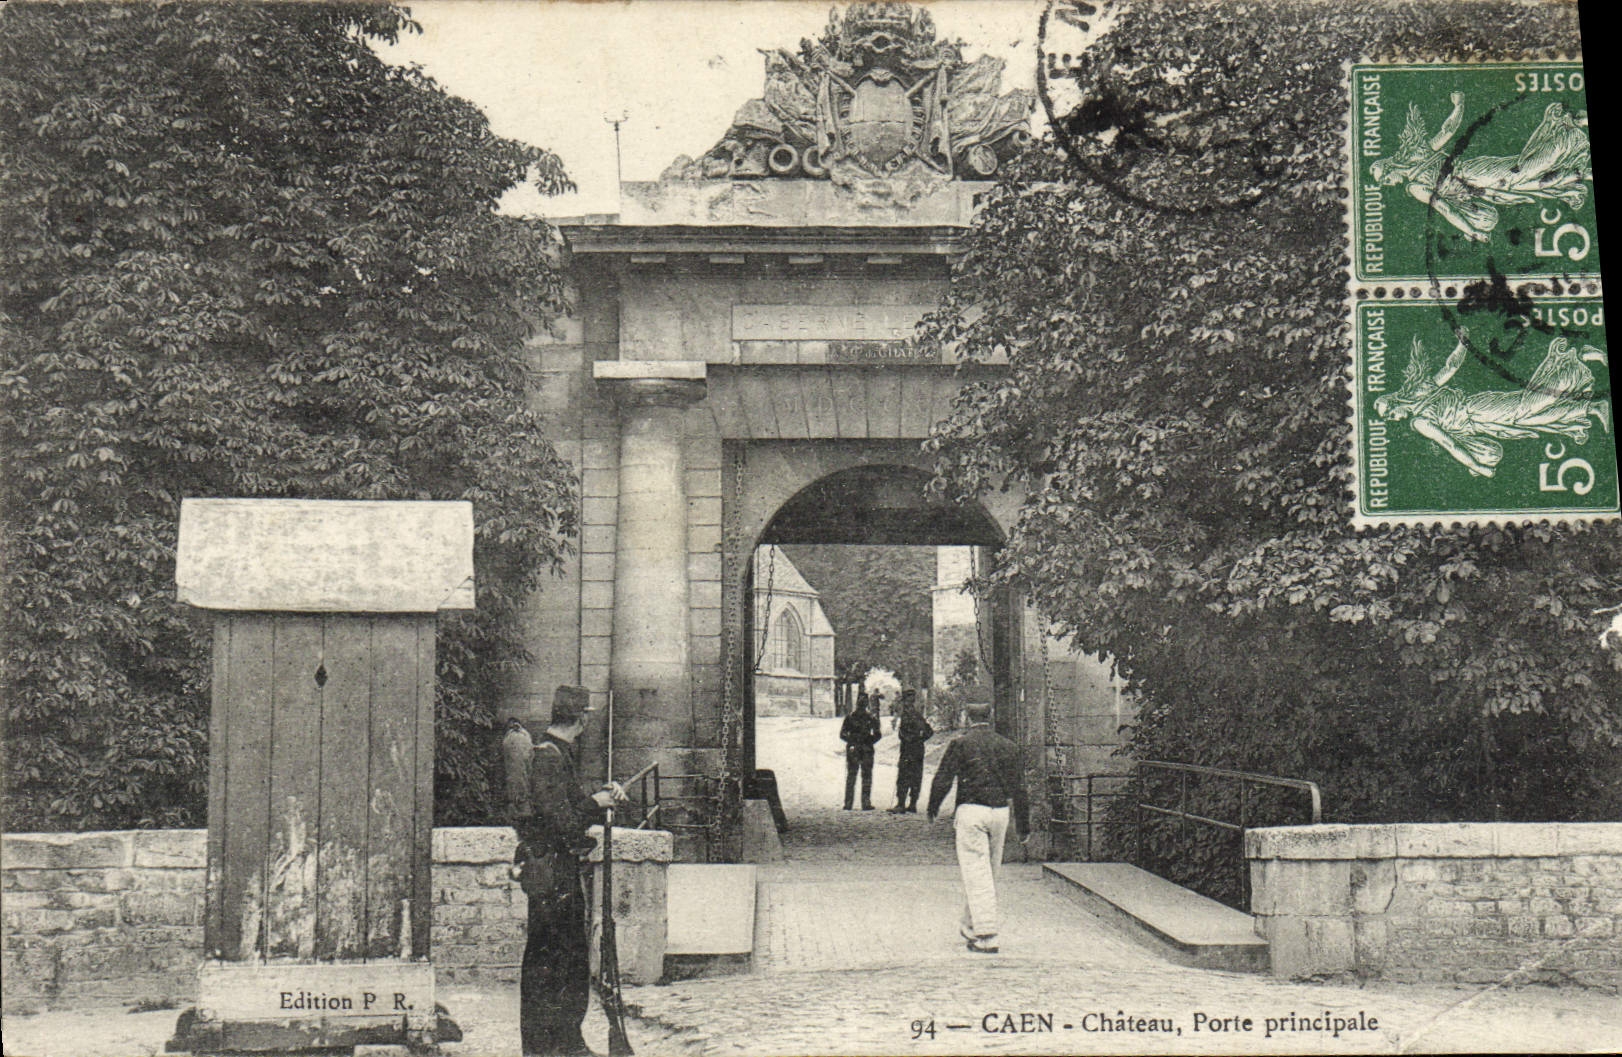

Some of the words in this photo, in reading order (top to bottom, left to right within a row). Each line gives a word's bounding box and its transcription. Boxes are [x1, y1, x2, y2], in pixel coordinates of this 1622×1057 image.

[1362, 74, 1384, 156] FRANÇAISE
[1364, 184, 1384, 273] REPUBLIQUE
[1367, 309, 1389, 392] FRANÇAISE
[1369, 419, 1389, 508] REPUBLIQUE
